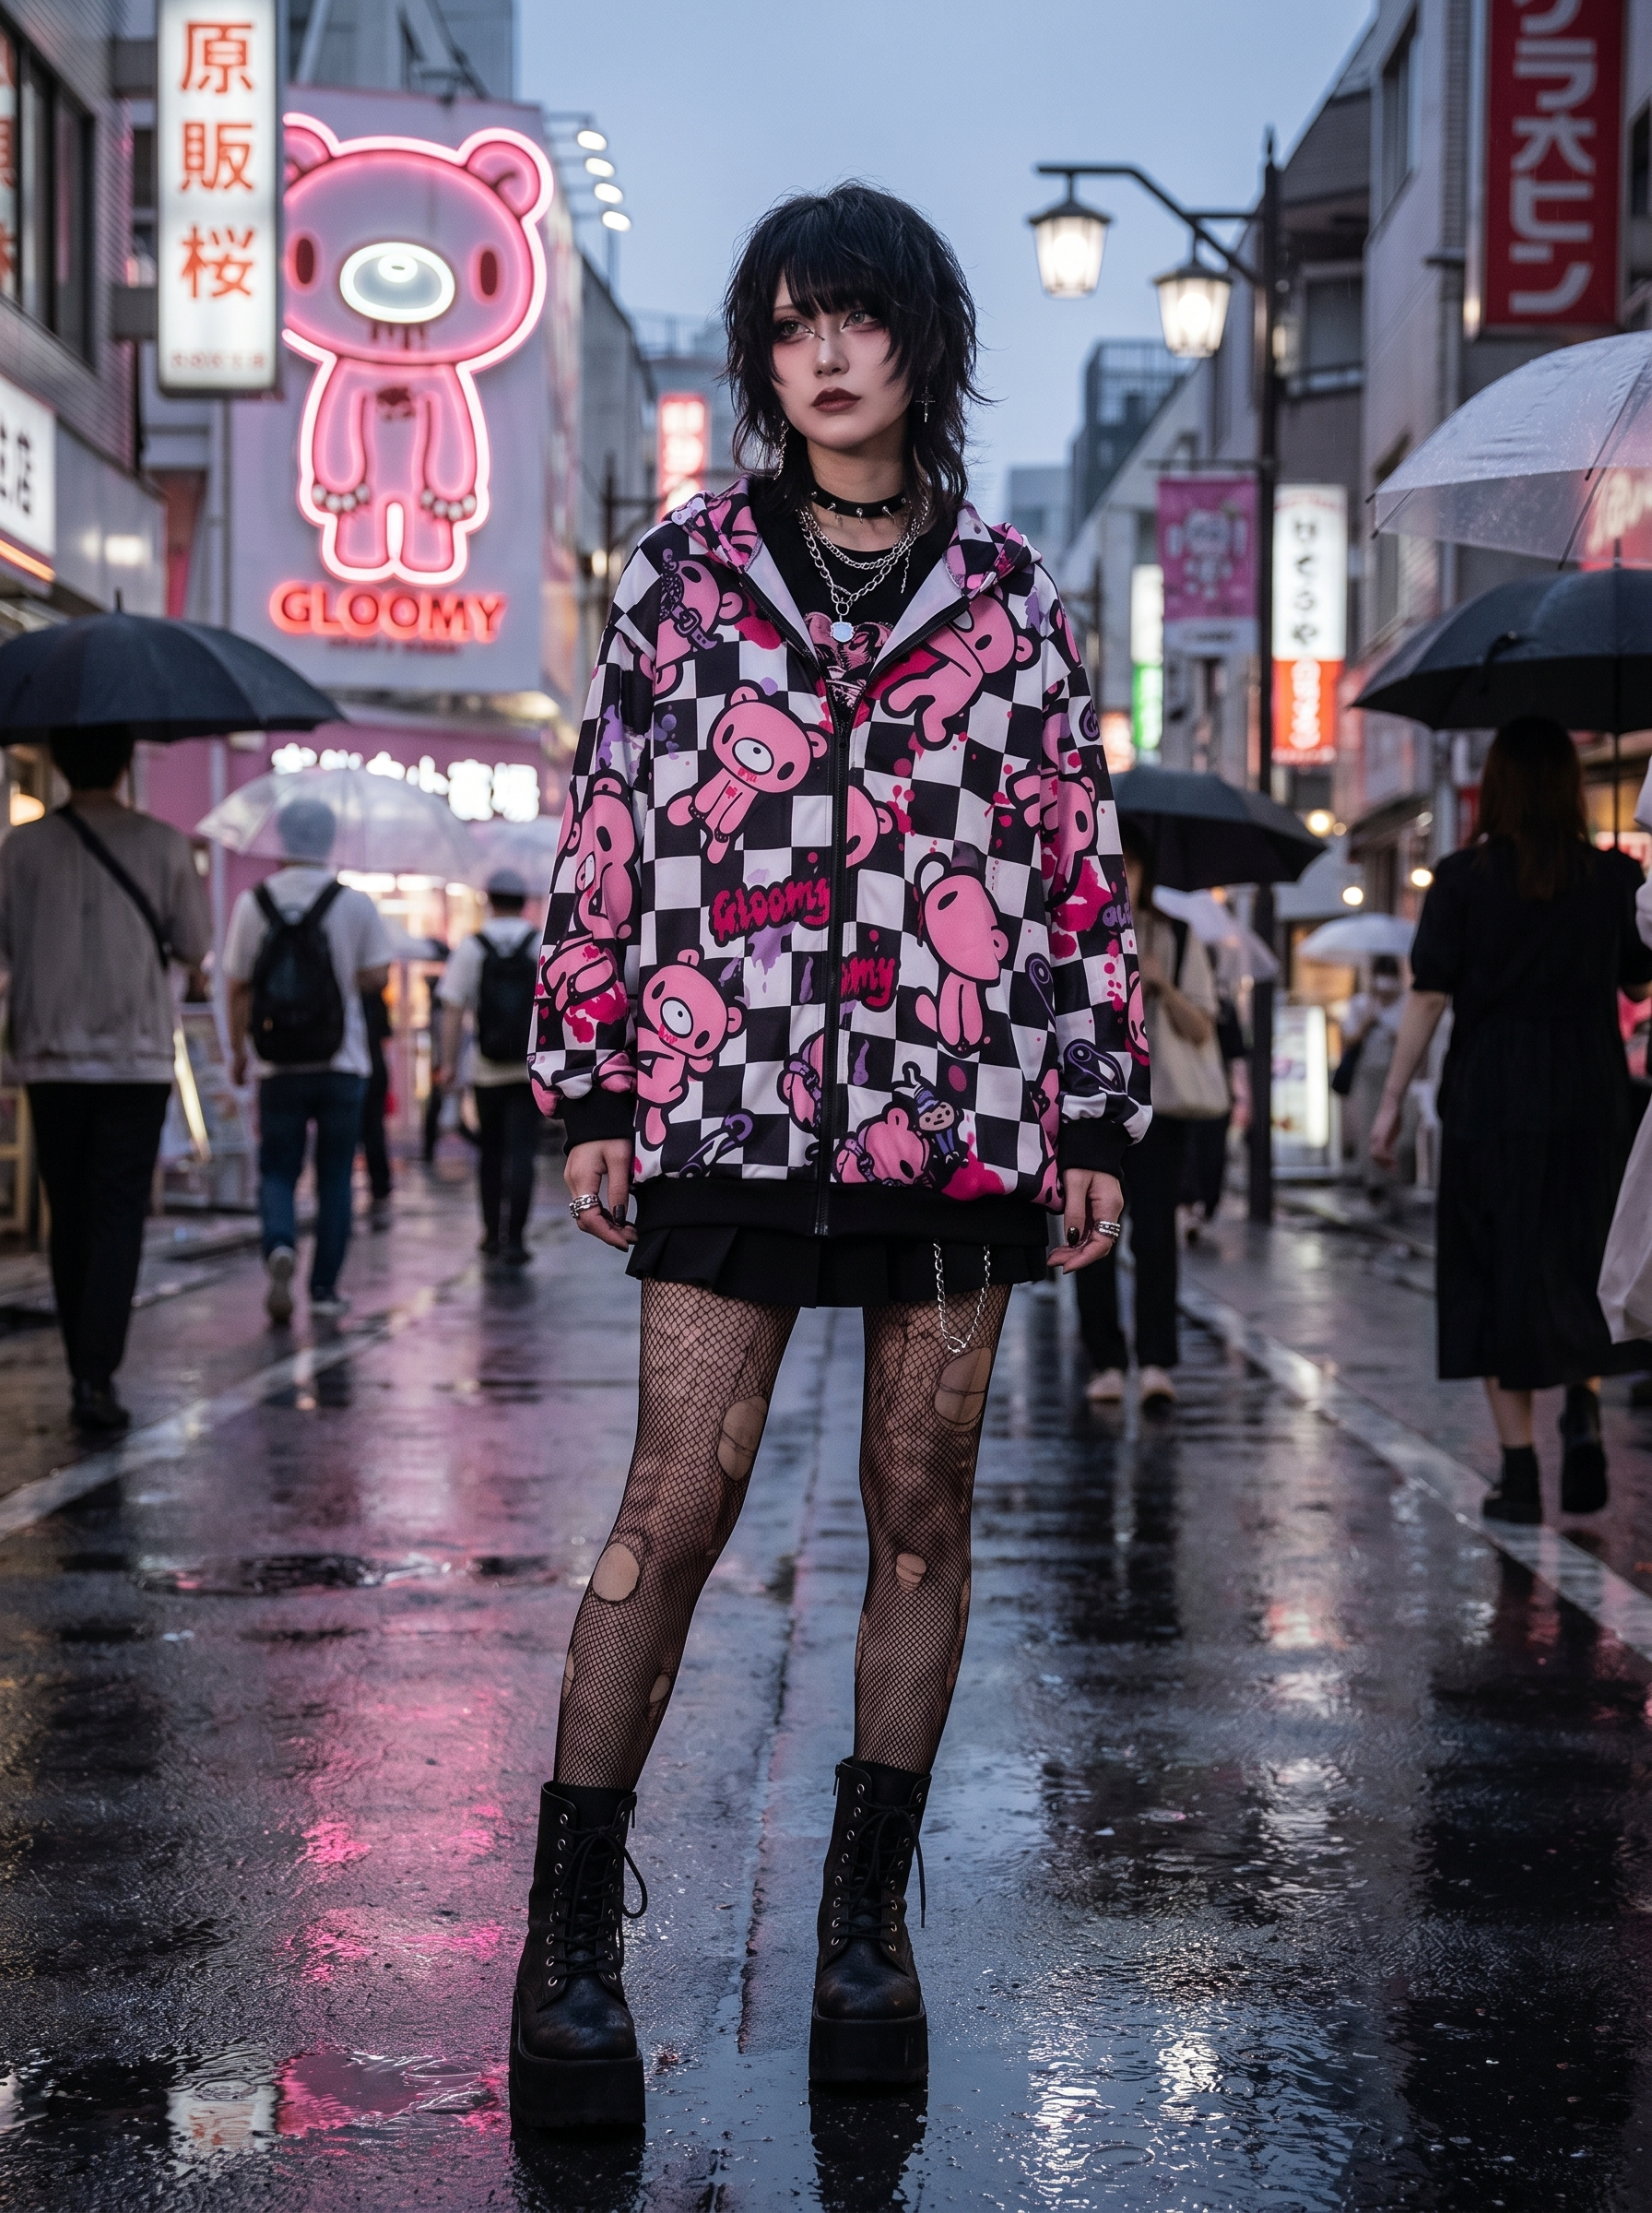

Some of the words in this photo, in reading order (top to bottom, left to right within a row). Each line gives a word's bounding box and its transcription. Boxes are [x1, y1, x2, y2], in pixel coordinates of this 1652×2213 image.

[181, 21, 254, 300] 原販桜
[268, 581, 509, 644] GLOOMY
[713, 877, 830, 941] Gloomy
